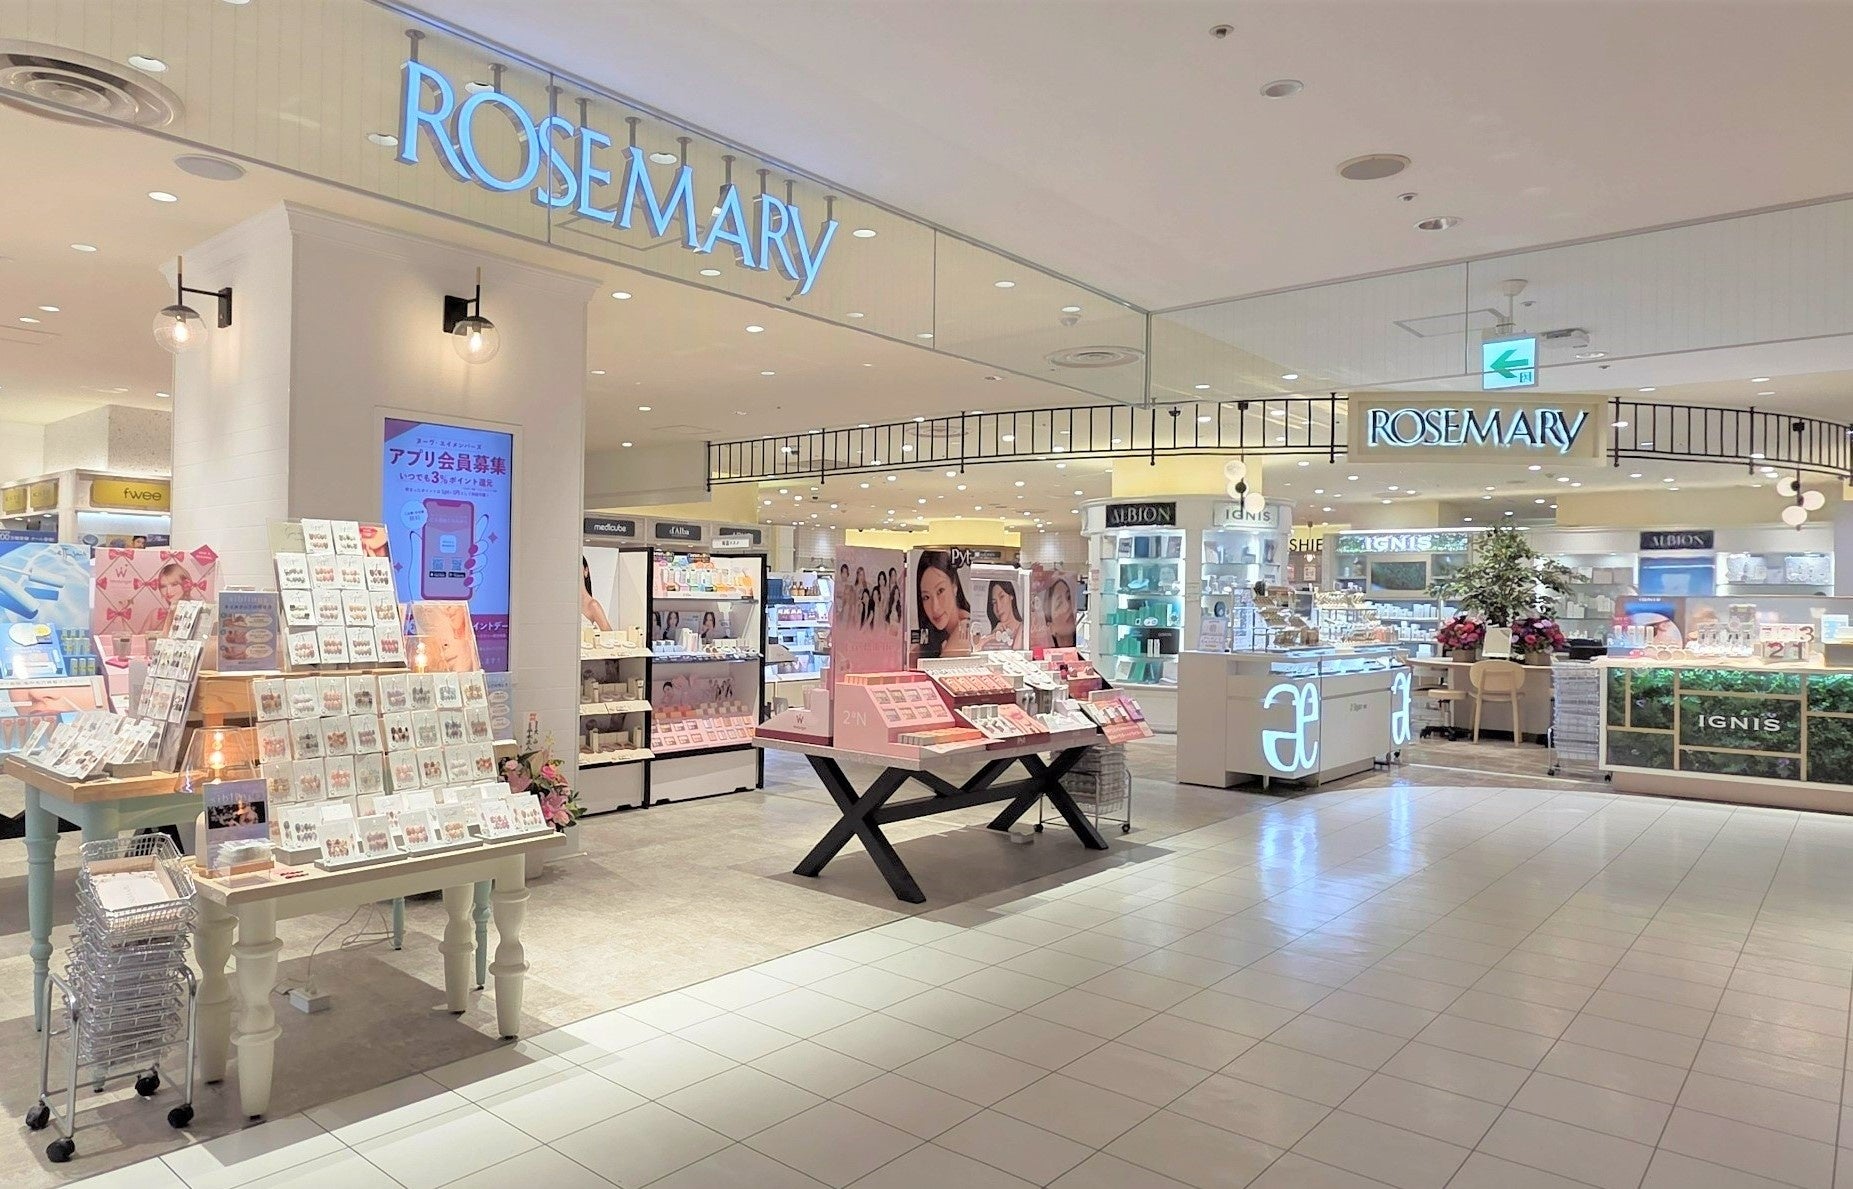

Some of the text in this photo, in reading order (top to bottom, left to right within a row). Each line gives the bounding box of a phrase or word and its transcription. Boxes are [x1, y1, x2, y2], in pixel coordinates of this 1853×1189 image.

[396, 60, 839, 298] ROSEMARY
[1368, 407, 1589, 453] ROSEMARY
[389, 448, 506, 475] アプリ会員募集
[123, 487, 162, 501] fwee
[1112, 506, 1171, 524] ALBION
[1225, 508, 1271, 522] IGNIS
[593, 523, 627, 533] medicube
[1363, 535, 1433, 550] IGNIS
[1652, 534, 1705, 548] ALBION
[1698, 714, 1781, 732] IGNIS
